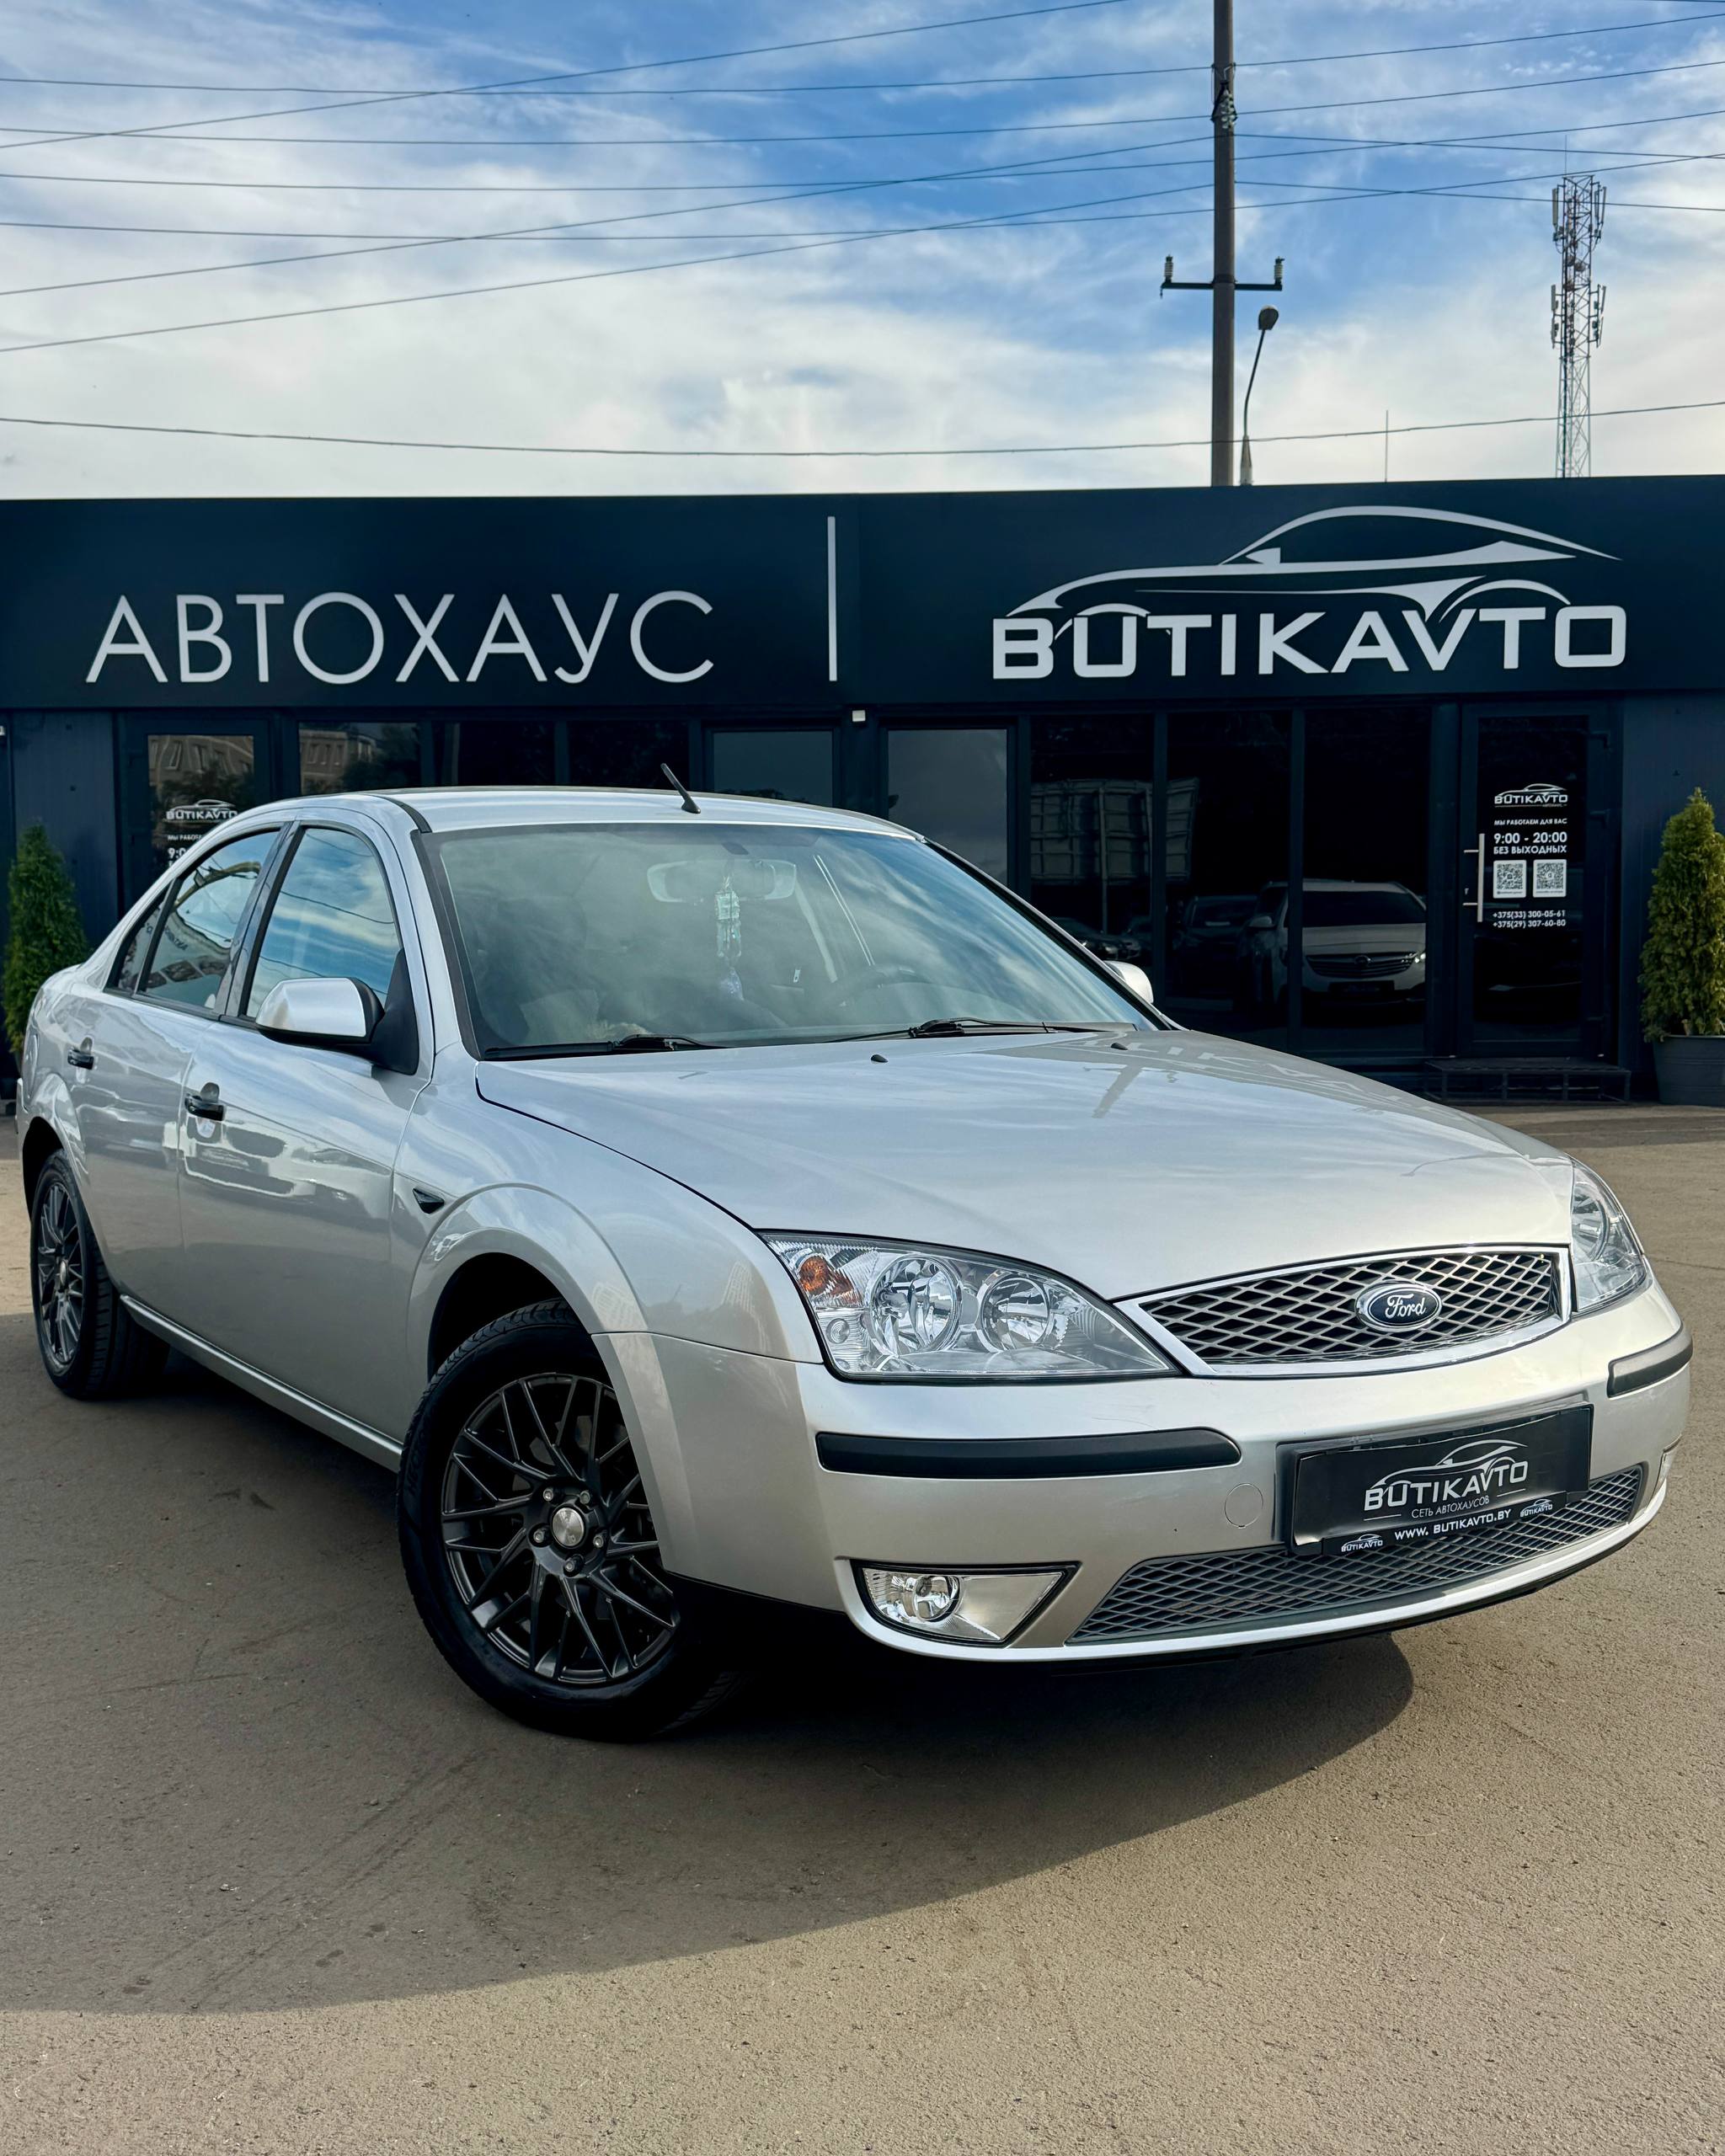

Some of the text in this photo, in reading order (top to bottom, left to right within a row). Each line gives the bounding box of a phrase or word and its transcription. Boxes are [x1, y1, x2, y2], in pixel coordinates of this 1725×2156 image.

[86, 590, 714, 685] АВТОХАУС
[992, 605, 1627, 680] BUTIKAVTO
[1494, 794, 1568, 804] BUTIKAVTO
[1494, 833, 1520, 844] 9:00
[1533, 831, 1567, 843] 20:00
[1493, 845, 1567, 855] БЕЗ ВЫХОДНЫХ
[1493, 910, 1566, 920] +375(33) 300-05-61
[1493, 919, 1566, 929] +375(29) 307-60-80
[1385, 1294, 1427, 1319] Ford
[1364, 1460, 1528, 1511] BUTIKAVTO
[1411, 1496, 1489, 1518] СЕТЬ АВТОХАУСОВ
[1519, 1503, 1553, 1518] BUTIKAVTO
[1394, 1508, 1512, 1540] WWW. BUTIKAVTO.BY
[1341, 1540, 1383, 1552] BUTIKAVTO
